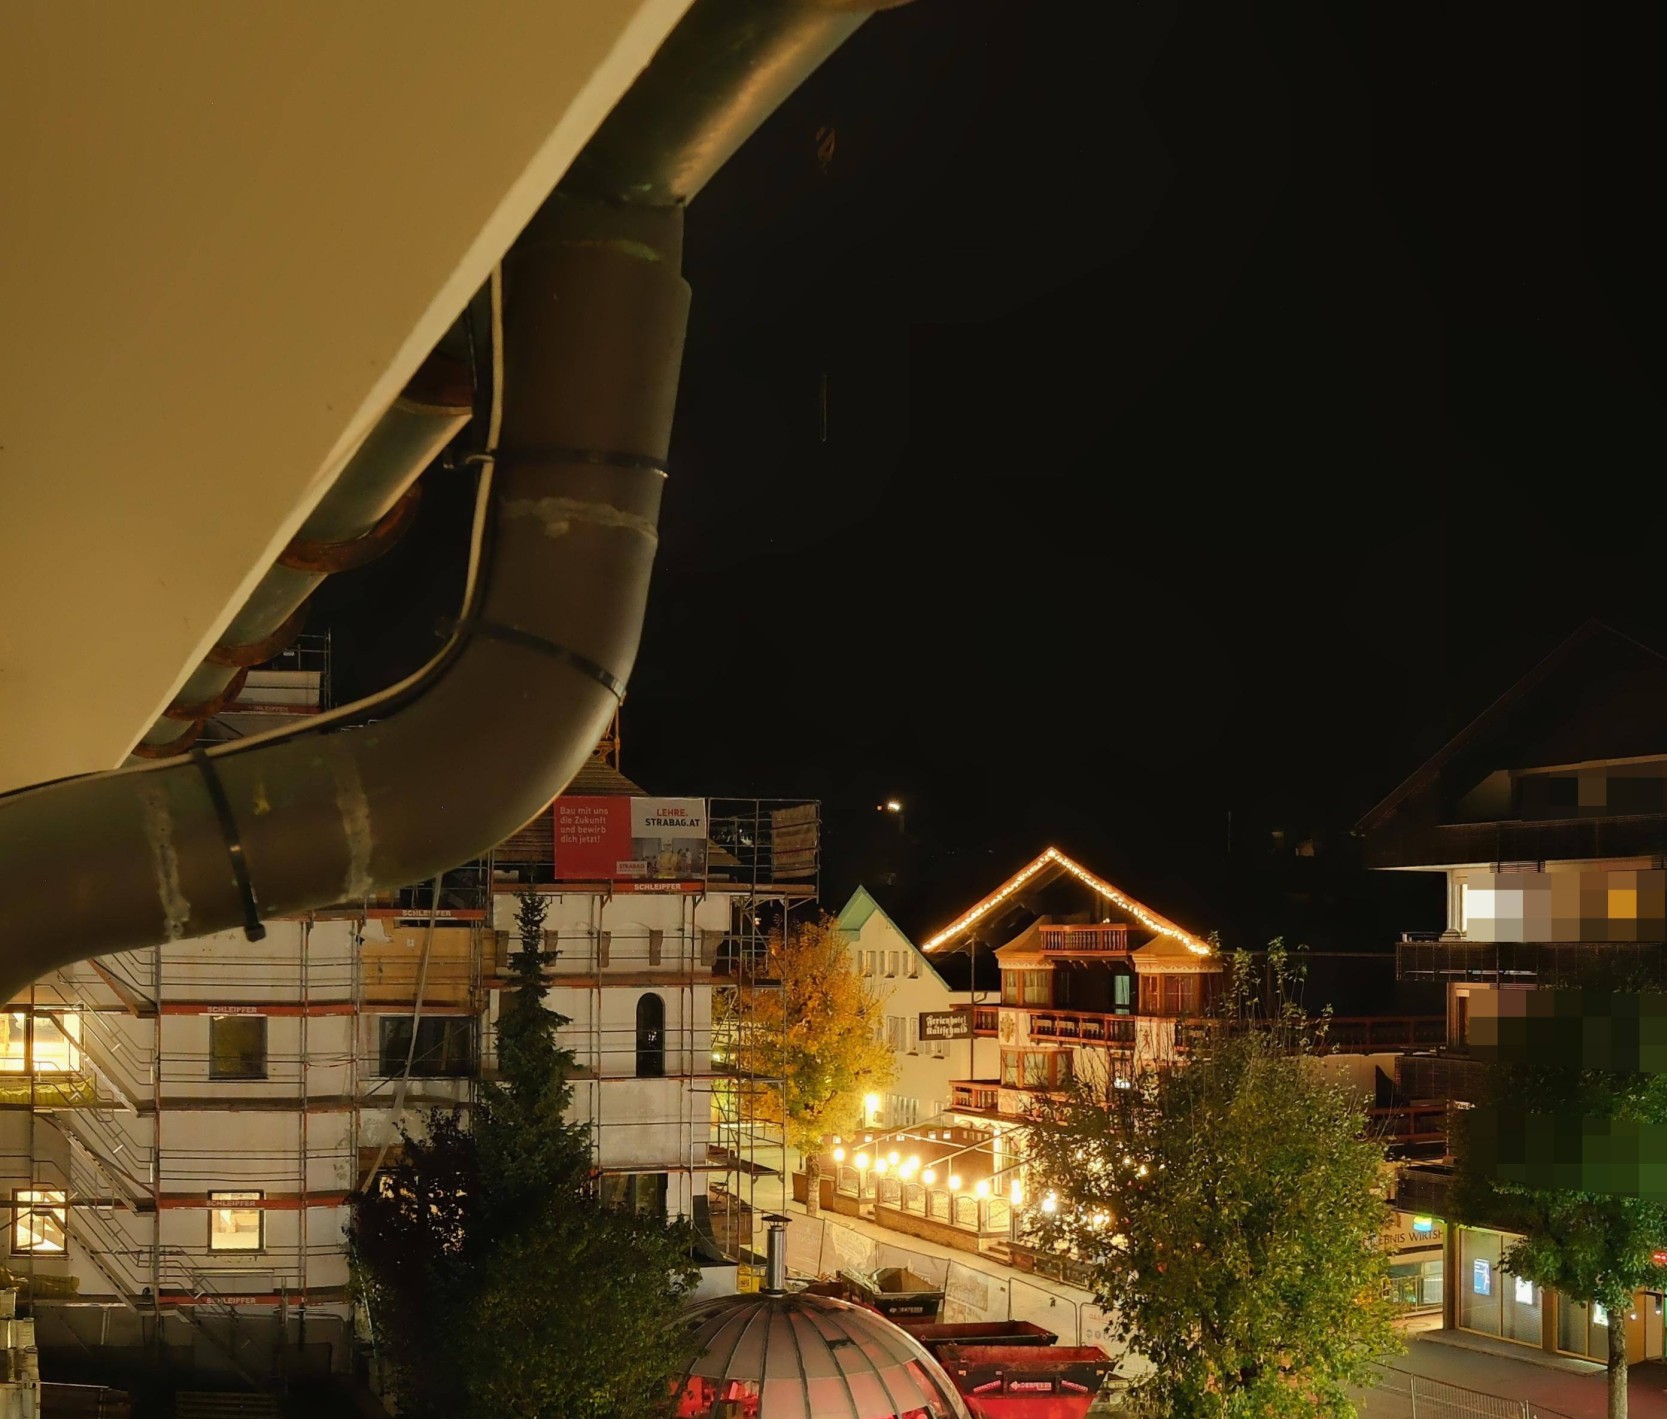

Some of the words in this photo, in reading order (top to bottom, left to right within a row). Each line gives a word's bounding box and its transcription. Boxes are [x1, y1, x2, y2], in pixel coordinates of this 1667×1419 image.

[560, 807, 576, 815] Bau
[578, 807, 592, 815] mit
[656, 808, 689, 817] LEHRE.
[560, 816, 573, 824] die
[574, 816, 606, 824] Zukunft
[645, 818, 700, 827] STRABAG.AT
[560, 826, 576, 834] und
[578, 826, 606, 834] bewirb
[560, 835, 578, 843] dich
[402, 909, 451, 917] SCHLEIFER
